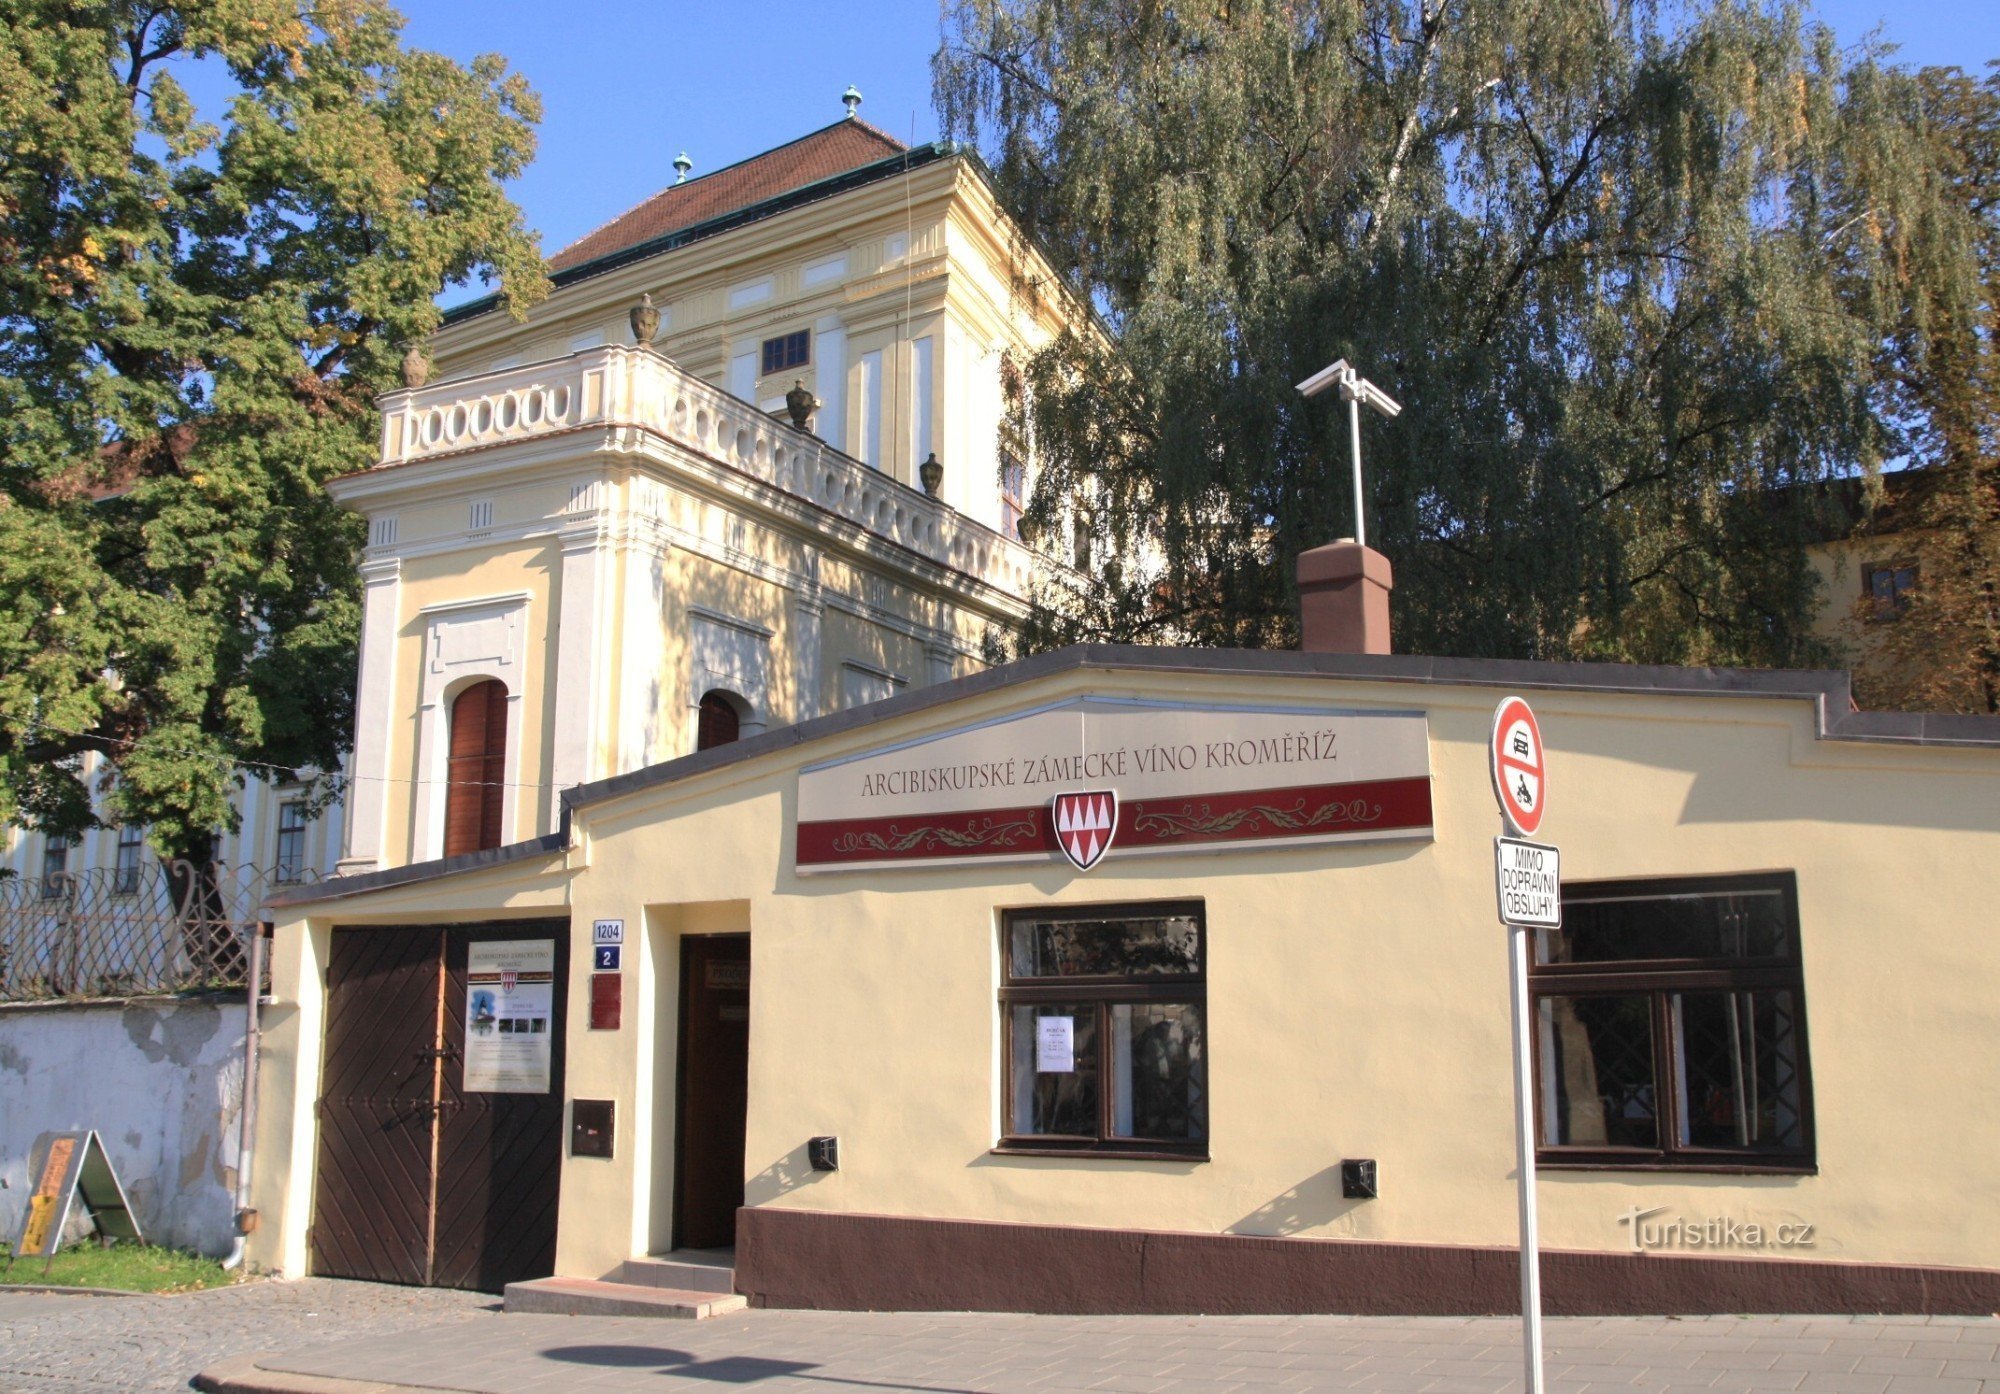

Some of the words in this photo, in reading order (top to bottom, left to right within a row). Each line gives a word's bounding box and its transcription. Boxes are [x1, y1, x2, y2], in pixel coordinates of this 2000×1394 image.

[861, 757, 1016, 797] ARCIBISKUPSKÉ
[1023, 747, 1127, 784] ZÁMECKÉ
[1133, 744, 1197, 774] VÍNO
[1205, 729, 1338, 769] KROMĚŘÍŽ
[1515, 847, 1543, 872] MIMO
[1503, 868, 1556, 895] DOPRAVNÍ
[1506, 892, 1554, 917] OBSLUHY
[597, 924, 619, 939] 1204
[603, 951, 611, 966] 2
